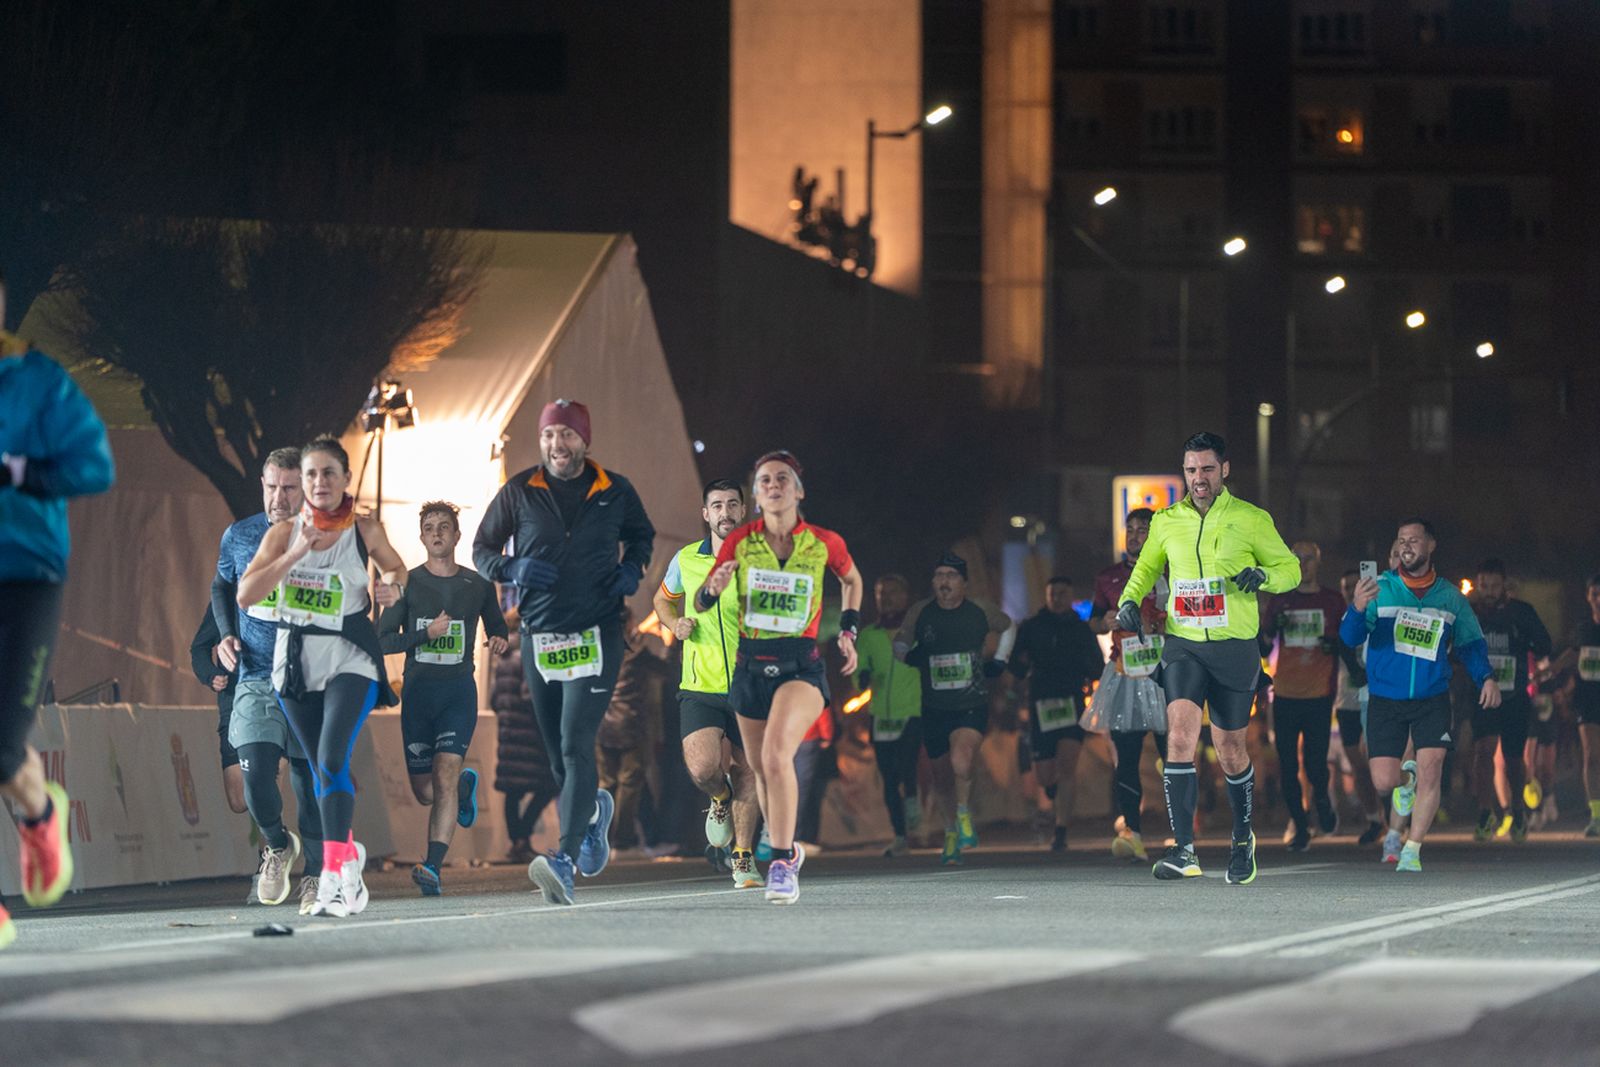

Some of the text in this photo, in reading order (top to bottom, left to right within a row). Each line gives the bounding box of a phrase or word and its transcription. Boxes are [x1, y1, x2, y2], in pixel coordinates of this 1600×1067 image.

[295, 588, 332, 608] 4215
[759, 591, 797, 612] 2145
[1403, 626, 1433, 644] 1556
[548, 645, 590, 665] 8369
